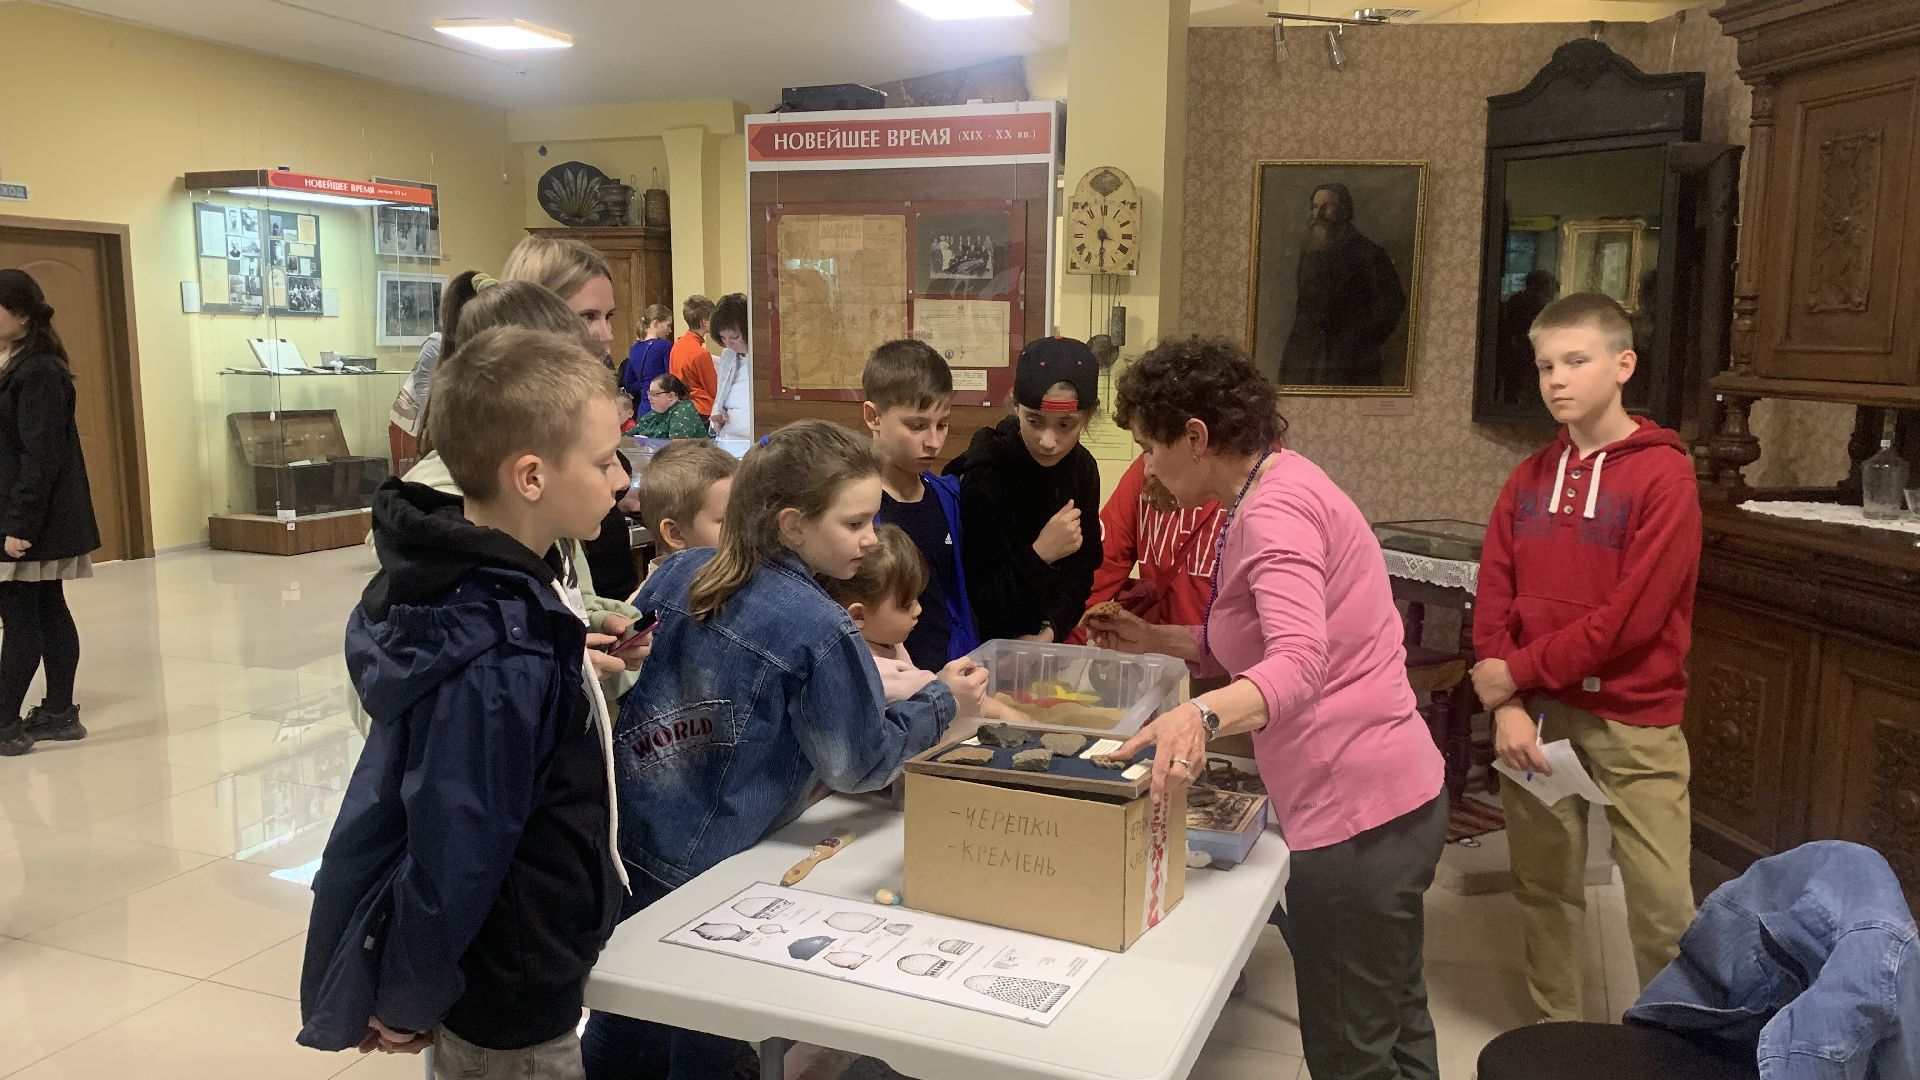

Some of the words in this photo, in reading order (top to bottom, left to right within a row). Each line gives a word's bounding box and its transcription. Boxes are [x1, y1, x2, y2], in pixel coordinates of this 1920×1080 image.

[773, 127, 881, 151] НОВЕЙШЕЕ
[886, 126, 951, 148] ВРЕМЯ
[957, 129, 984, 142] (XIX
[995, 129, 1013, 140] XX
[1017, 129, 1037, 141] вв.)
[304, 178, 349, 192] НОВЕЙШЕЕ
[350, 184, 375, 195] ВРЕМЯ
[632, 716, 713, 759] WORLD
